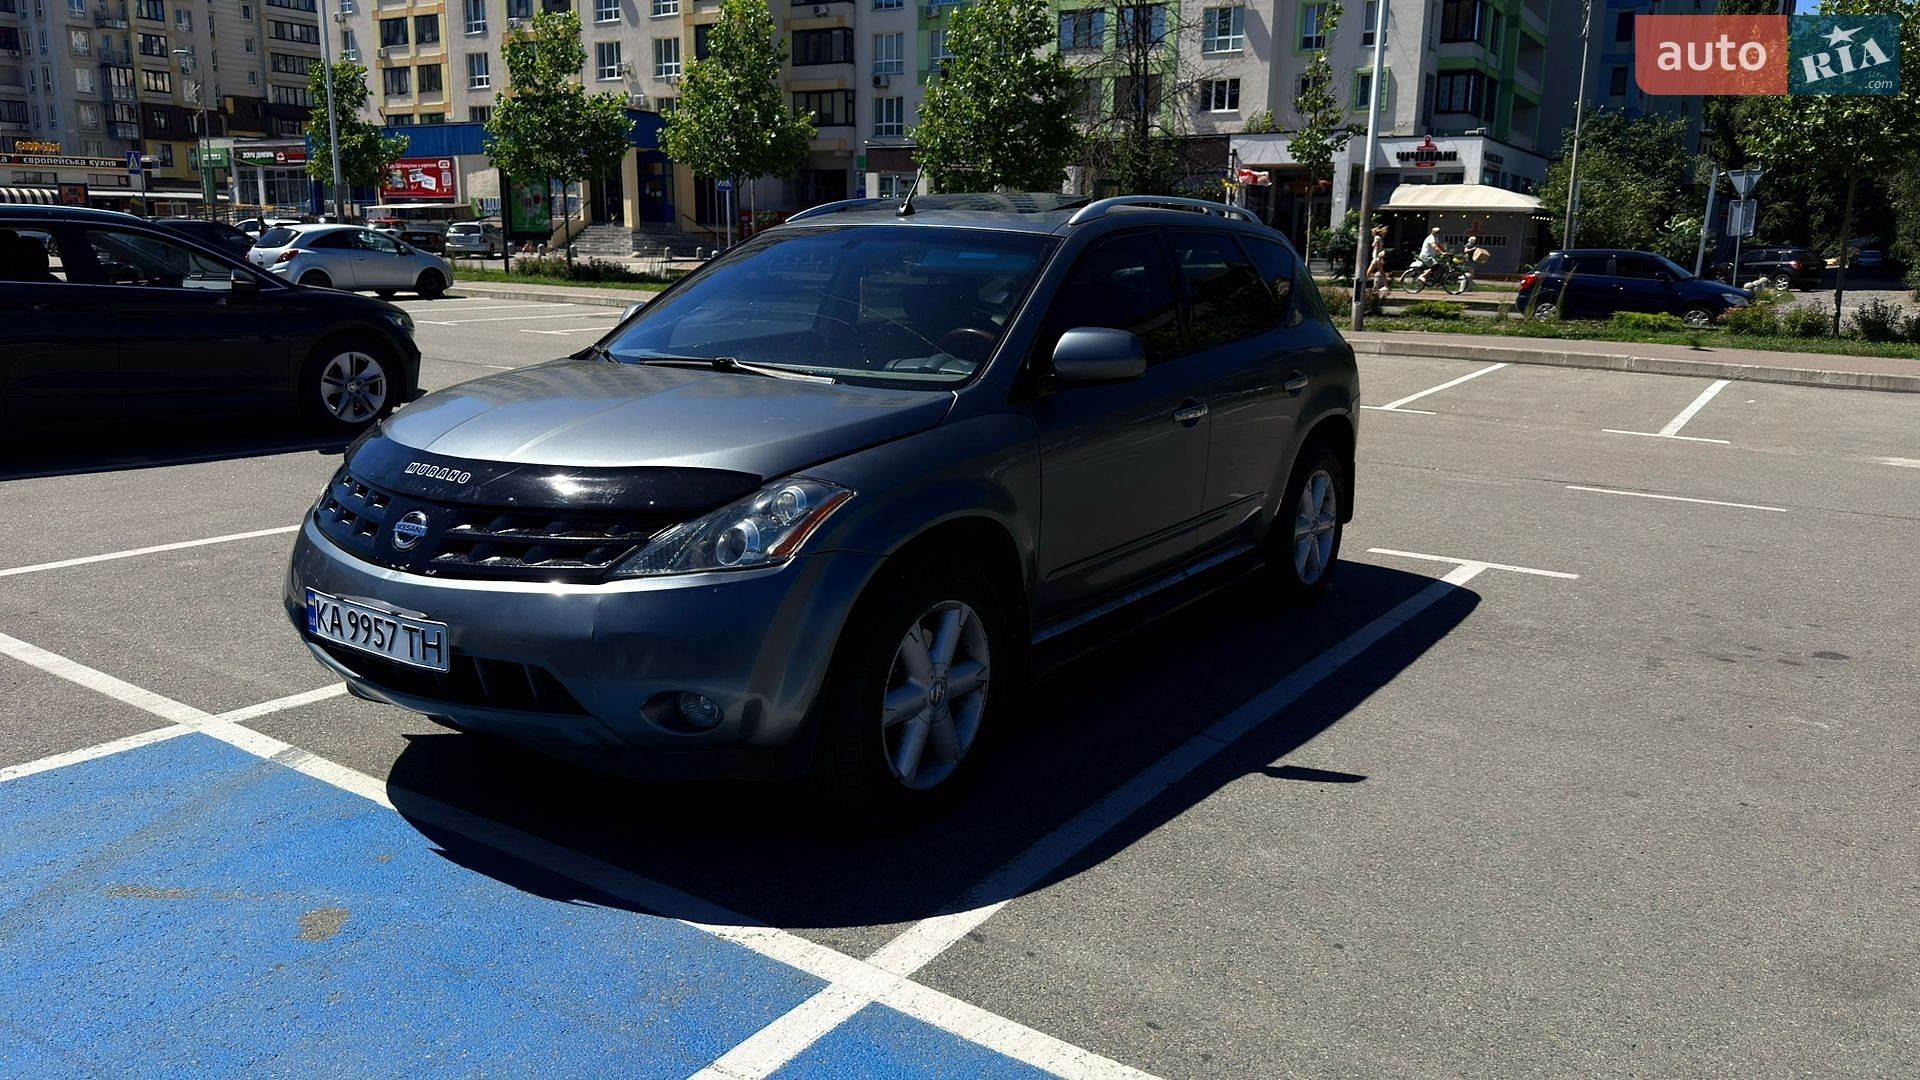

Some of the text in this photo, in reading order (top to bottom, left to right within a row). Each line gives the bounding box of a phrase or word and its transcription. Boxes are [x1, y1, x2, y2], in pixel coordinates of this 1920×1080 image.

[404, 462, 472, 484] MURANO
[316, 599, 441, 663] KA 9957 TH
